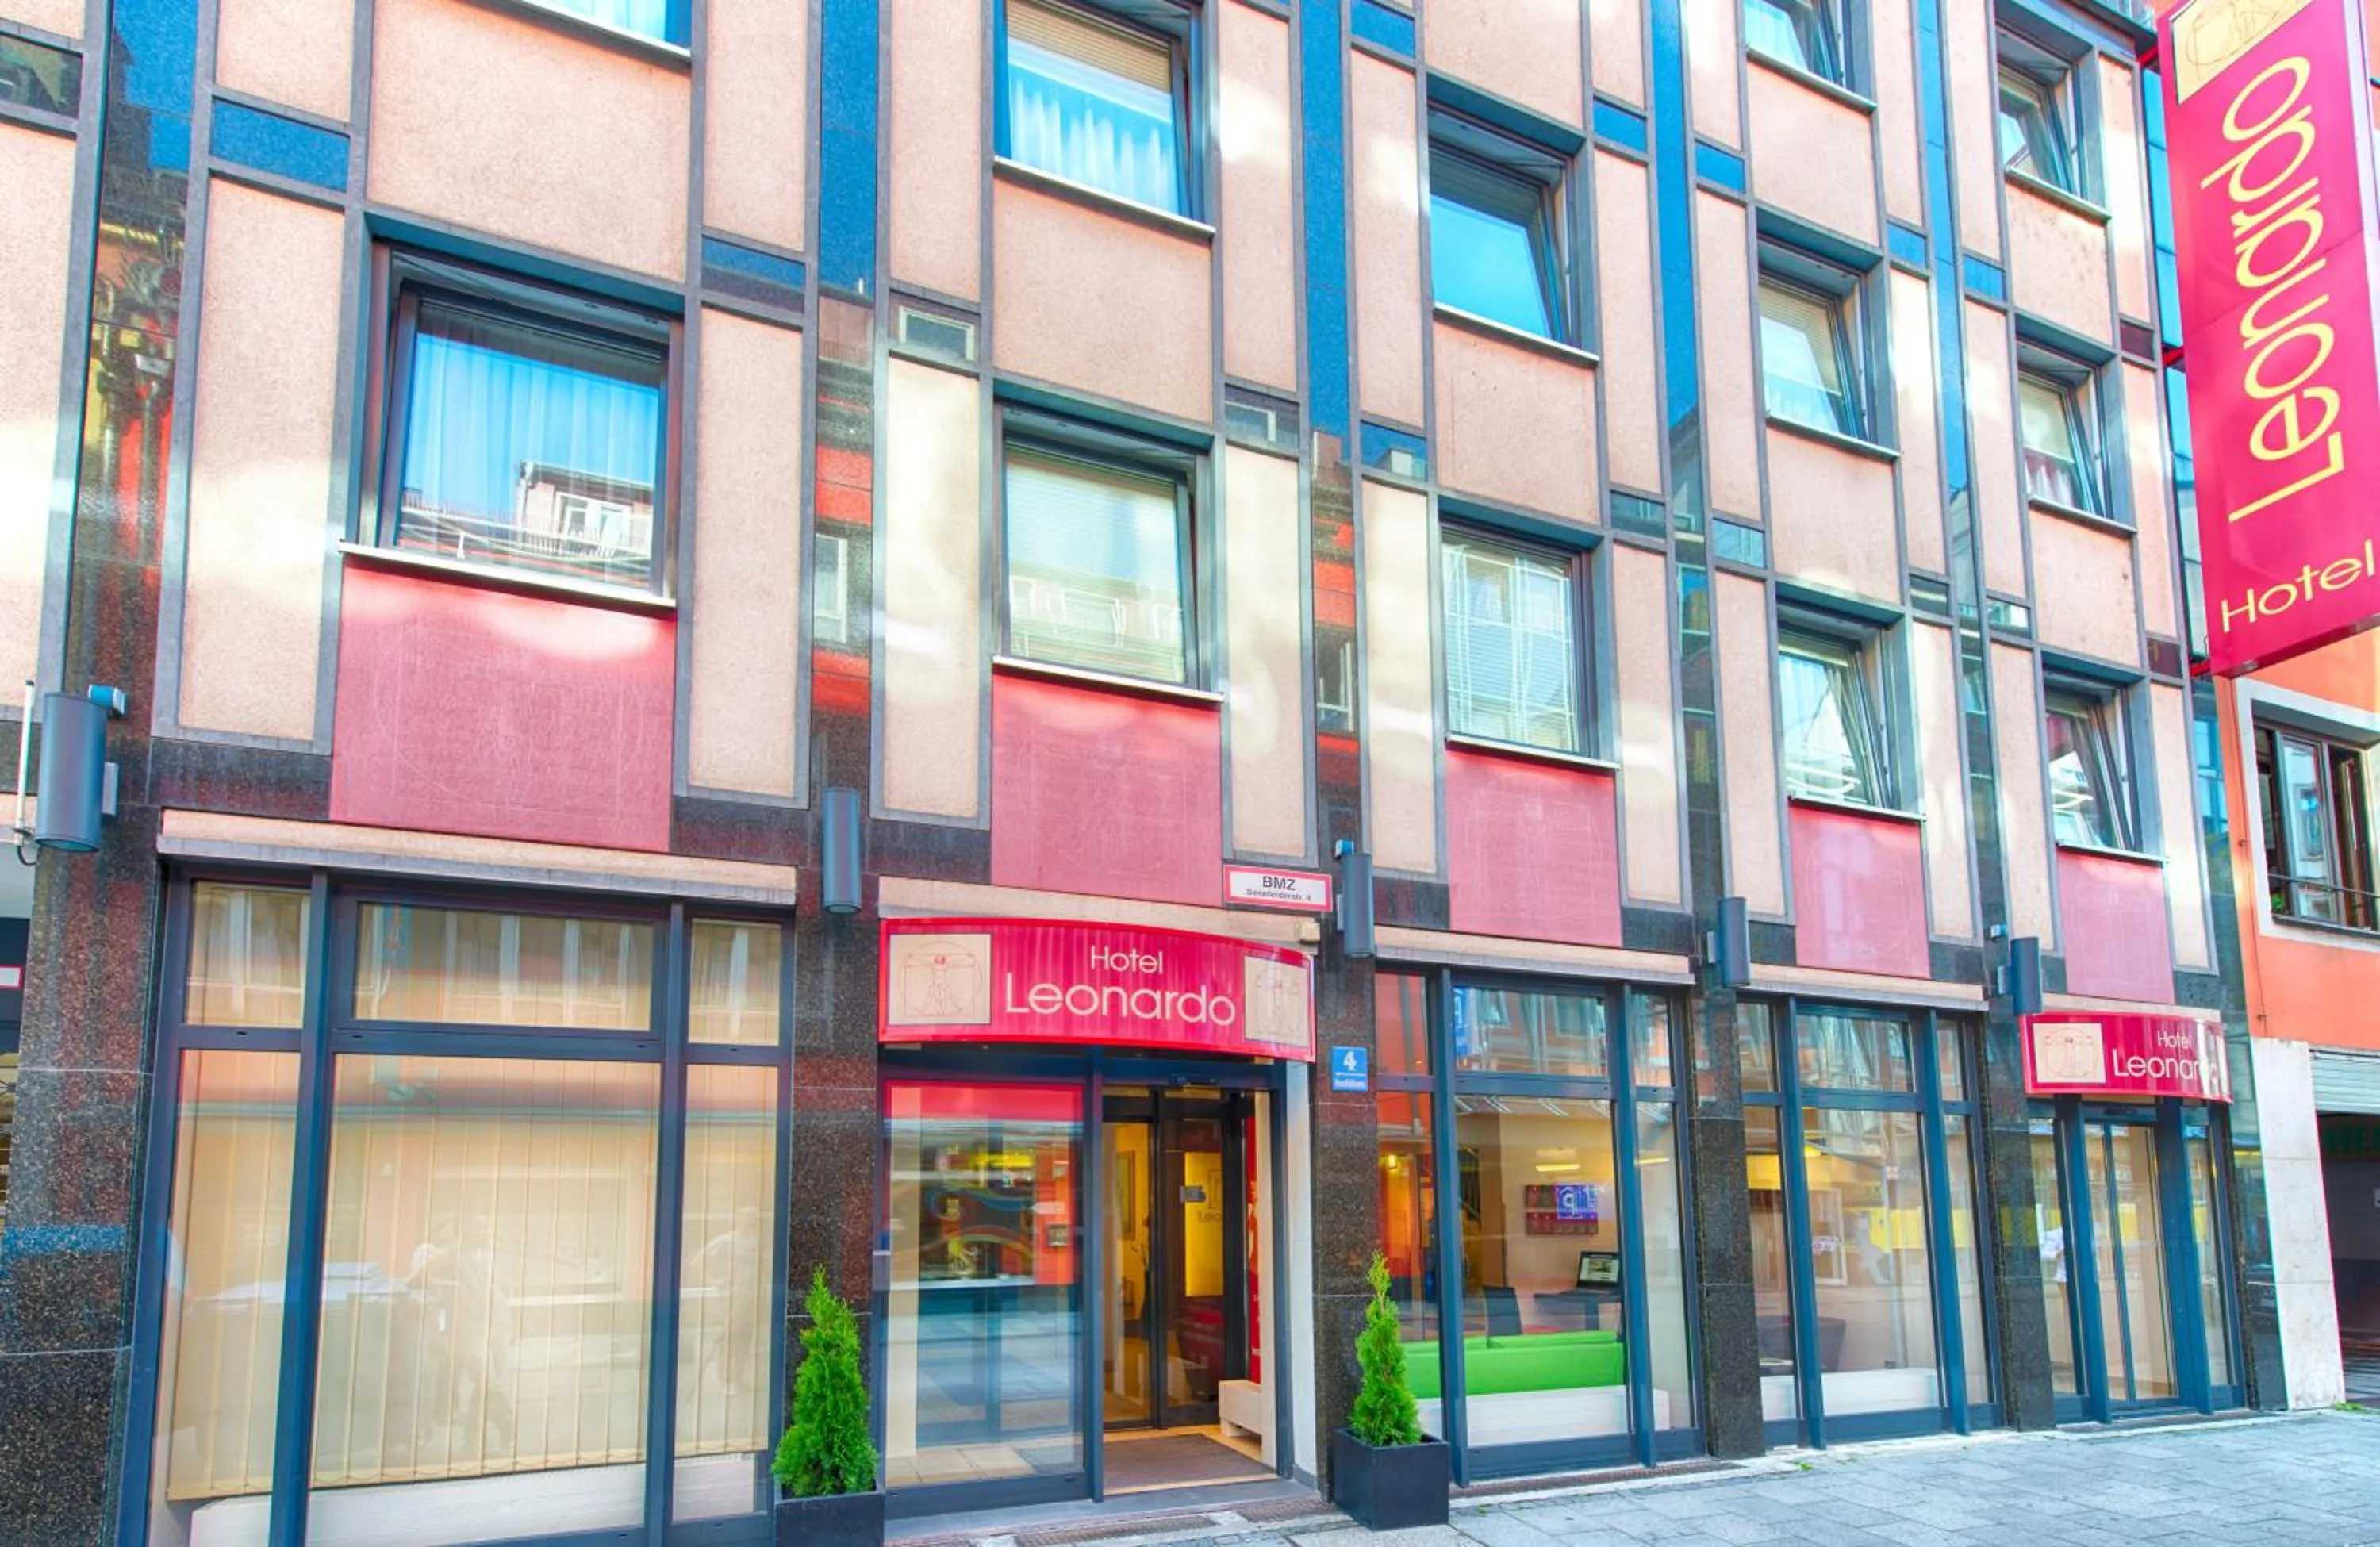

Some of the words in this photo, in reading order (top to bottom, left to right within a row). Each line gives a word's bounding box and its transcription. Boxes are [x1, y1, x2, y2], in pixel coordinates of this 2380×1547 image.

[2200, 56, 2344, 523] Leonardo
[2221, 538, 2375, 633] Hotel
[1262, 875, 1296, 891] BMZ
[1090, 946, 1164, 976] Hotel
[1005, 973, 1236, 1027] Leonardo
[2157, 1031, 2192, 1050] Hotel
[1342, 1051, 1357, 1071] 4
[2112, 1047, 2219, 1084] Leonaro
